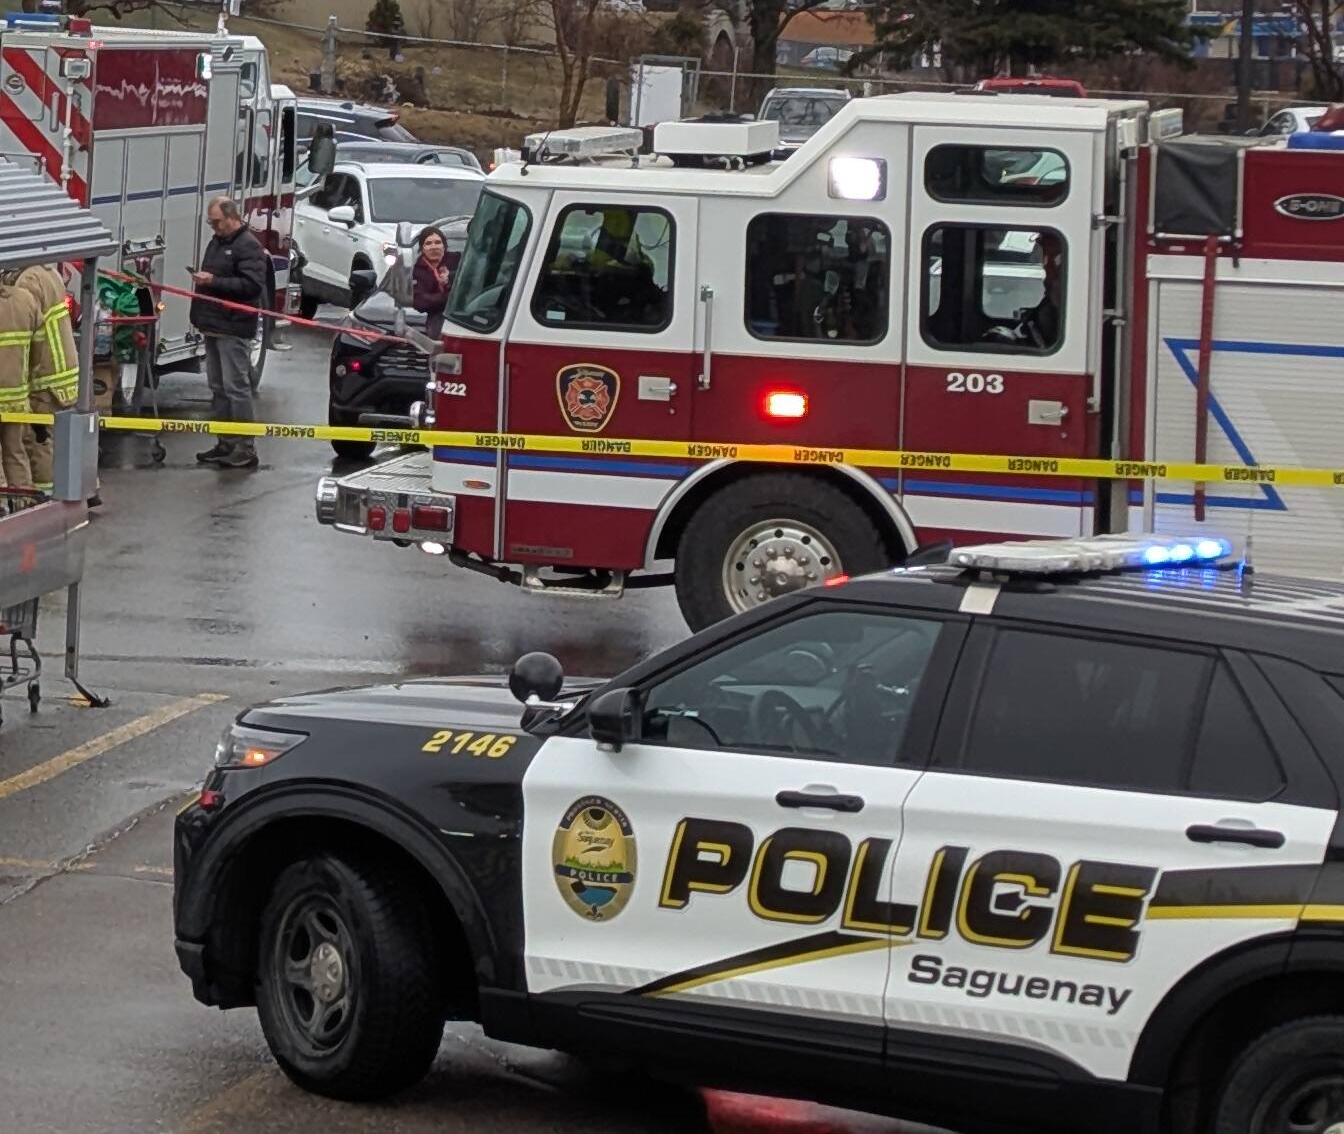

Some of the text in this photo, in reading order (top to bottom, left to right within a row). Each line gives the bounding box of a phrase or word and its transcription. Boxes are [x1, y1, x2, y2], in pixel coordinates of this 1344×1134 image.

[946, 372, 1004, 394] 203
[162, 421, 210, 433] DANGER
[265, 426, 315, 438] DANGER
[371, 430, 420, 443] DANGER
[476, 435, 526, 449] DANGER
[582, 439, 631, 453] DANGER
[688, 444, 737, 458] DANGER
[794, 449, 844, 463] DANGER
[900, 454, 951, 468] DANGER
[1007, 458, 1058, 473] DANGER
[1115, 462, 1167, 477] DANGER
[1223, 467, 1276, 482] DANGER
[421, 730, 517, 758] 2146
[569, 869, 618, 882] POLICE
[657, 815, 1160, 963] POLICE
[907, 954, 1133, 1015] Saguenay
